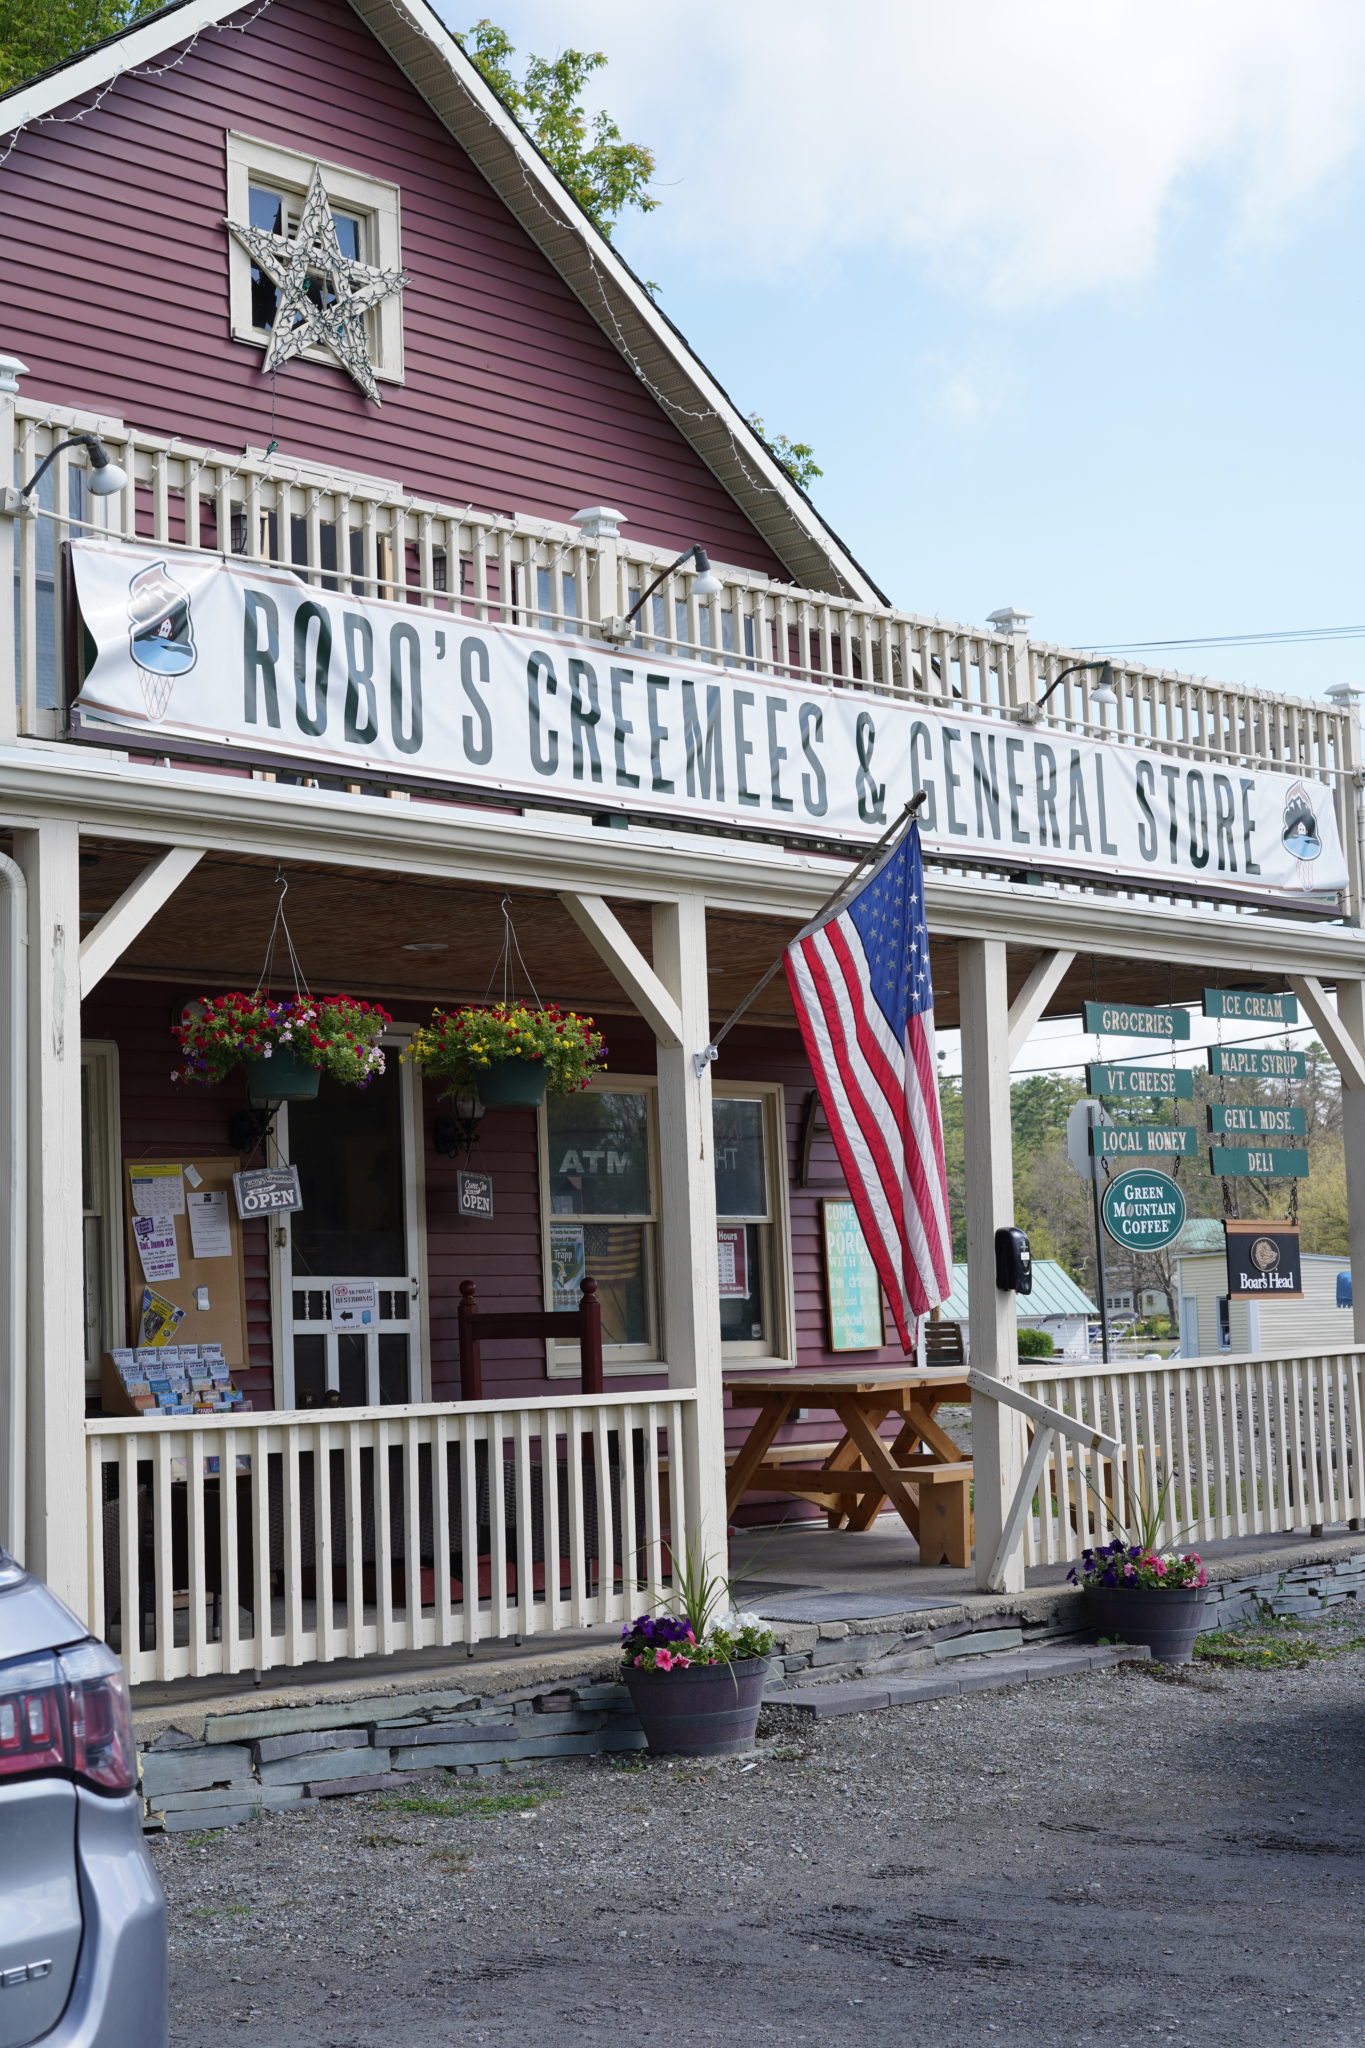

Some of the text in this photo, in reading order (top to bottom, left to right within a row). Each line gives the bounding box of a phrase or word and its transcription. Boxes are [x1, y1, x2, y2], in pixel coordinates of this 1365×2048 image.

[243, 588, 1261, 876] ROBO'S CREEMEES & GENERAL STORE
[1222, 995, 1283, 1018] ICE CREAM
[1102, 1010, 1174, 1034] GROCERIES
[1220, 1052, 1298, 1074] MAPLE SYRUP
[1107, 1070, 1176, 1092] VT. CHEESE
[1260, 1110, 1295, 1130] MDSE.
[1102, 1131, 1187, 1151] LOCAL HONEY
[559, 1149, 632, 1174] ATM
[1247, 1152, 1274, 1172] DELI
[244, 1189, 295, 1210] OPEN
[1124, 1184, 1163, 1200] GREEN
[463, 1194, 490, 1212] OPEN
[825, 1204, 855, 1220] COME
[1113, 1201, 1176, 1217] MOUNTAIN
[718, 1230, 738, 1240] Hours
[1122, 1219, 1169, 1234] COFFEE
[151, 1240, 164, 1249] June
[827, 1231, 868, 1255] PORC
[552, 1249, 573, 1262] Trapp
[828, 1256, 856, 1267] WITH
[1239, 1271, 1294, 1289] Boar's Head
[335, 1295, 373, 1304] RESTROOMS
[0, 1958, 53, 1987] ED
